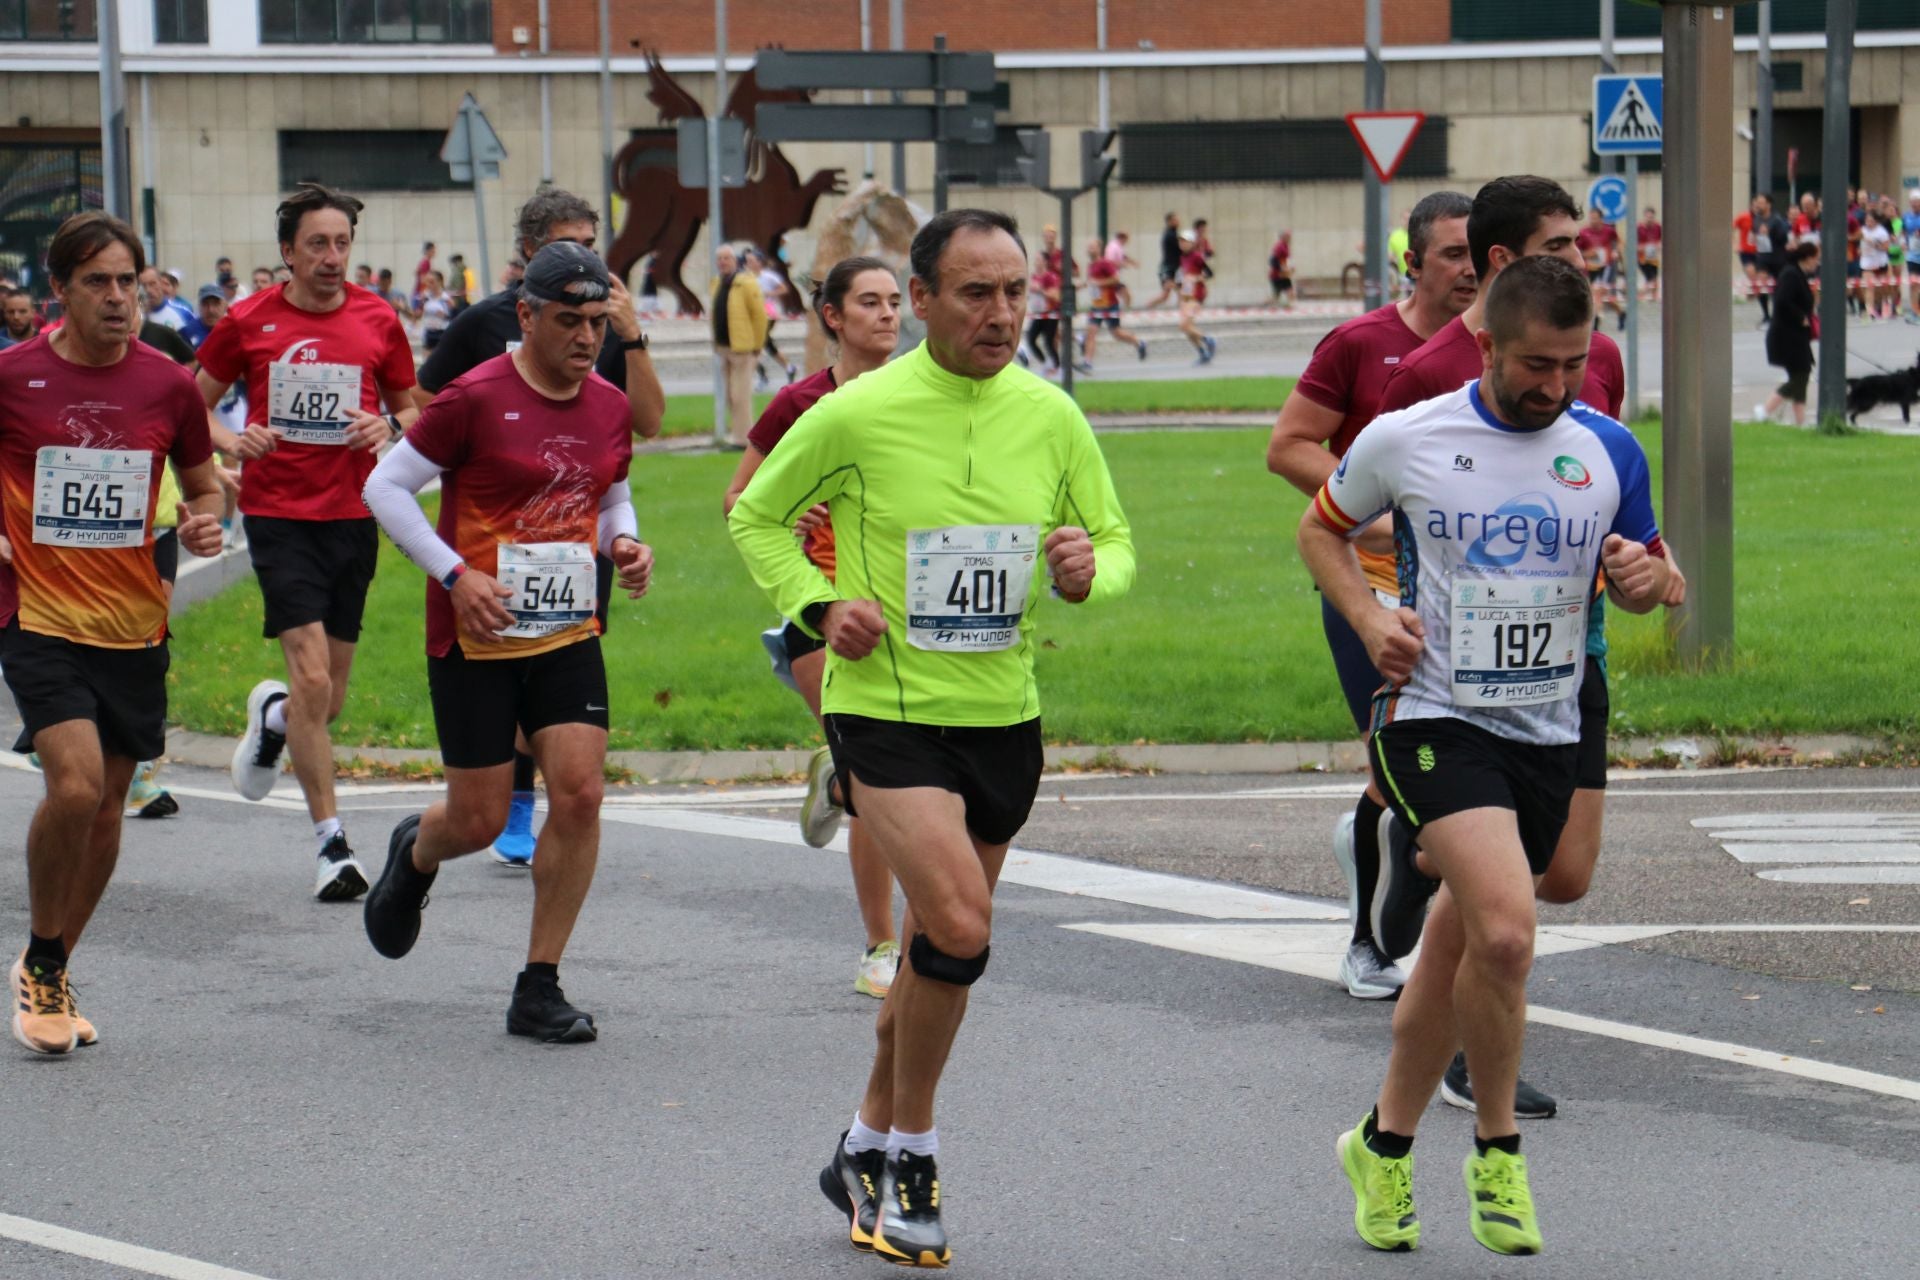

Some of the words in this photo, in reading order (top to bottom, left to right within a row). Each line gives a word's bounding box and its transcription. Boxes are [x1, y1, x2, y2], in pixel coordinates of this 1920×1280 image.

[300, 348, 317, 360] 30
[289, 391, 339, 421] 482
[62, 482, 124, 519] 645
[77, 531, 127, 541] HYUNDAI
[1427, 509, 1599, 557] arregui
[963, 556, 994, 567] TOMAS
[522, 575, 575, 611] 544
[946, 569, 1007, 614] 401
[1478, 610, 1511, 621] LUCIA
[1515, 609, 1529, 621] TE
[1534, 607, 1566, 620] QUIERO
[1493, 622, 1552, 669] 192
[1506, 681, 1560, 696] HYUNDAI
